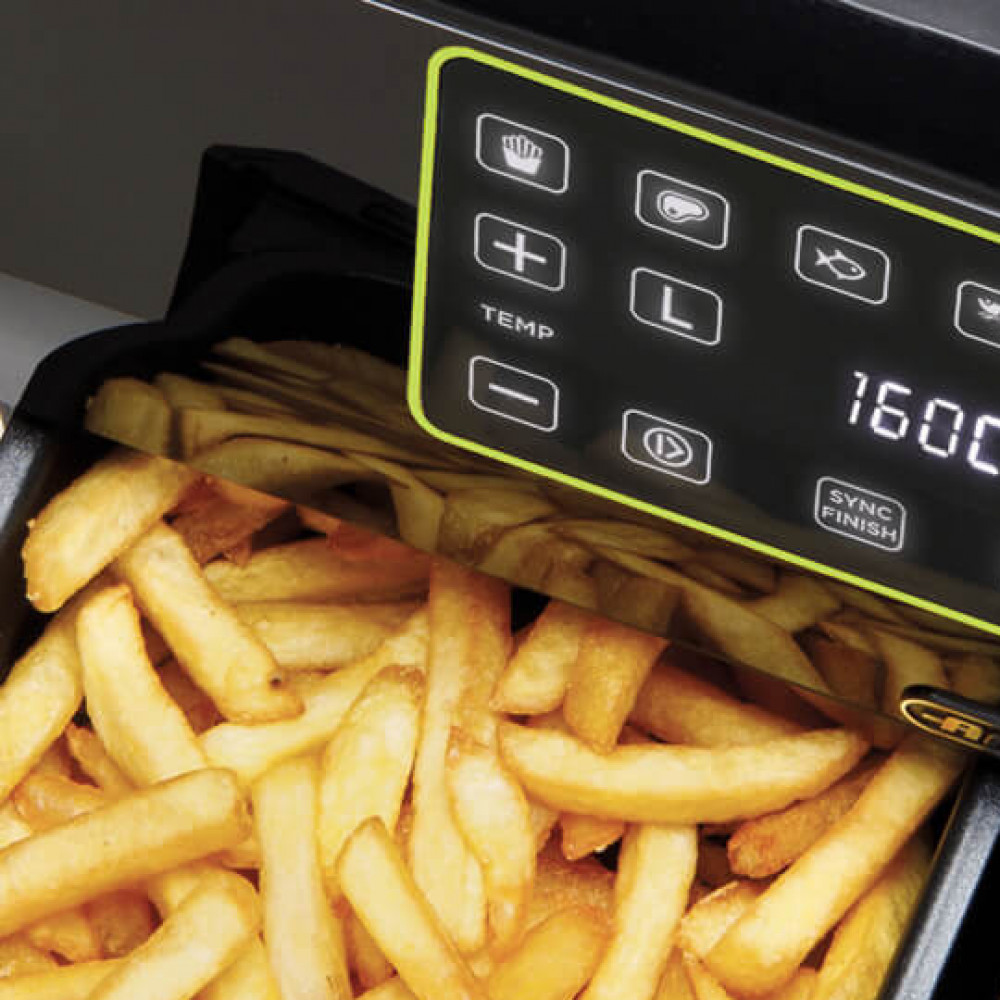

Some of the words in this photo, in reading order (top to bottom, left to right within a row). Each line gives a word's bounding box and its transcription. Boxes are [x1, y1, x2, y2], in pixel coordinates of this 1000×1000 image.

[479, 302, 556, 341] TEMP
[660, 285, 695, 331] L
[828, 487, 894, 522] SYNC
[821, 506, 898, 543] FINISH
